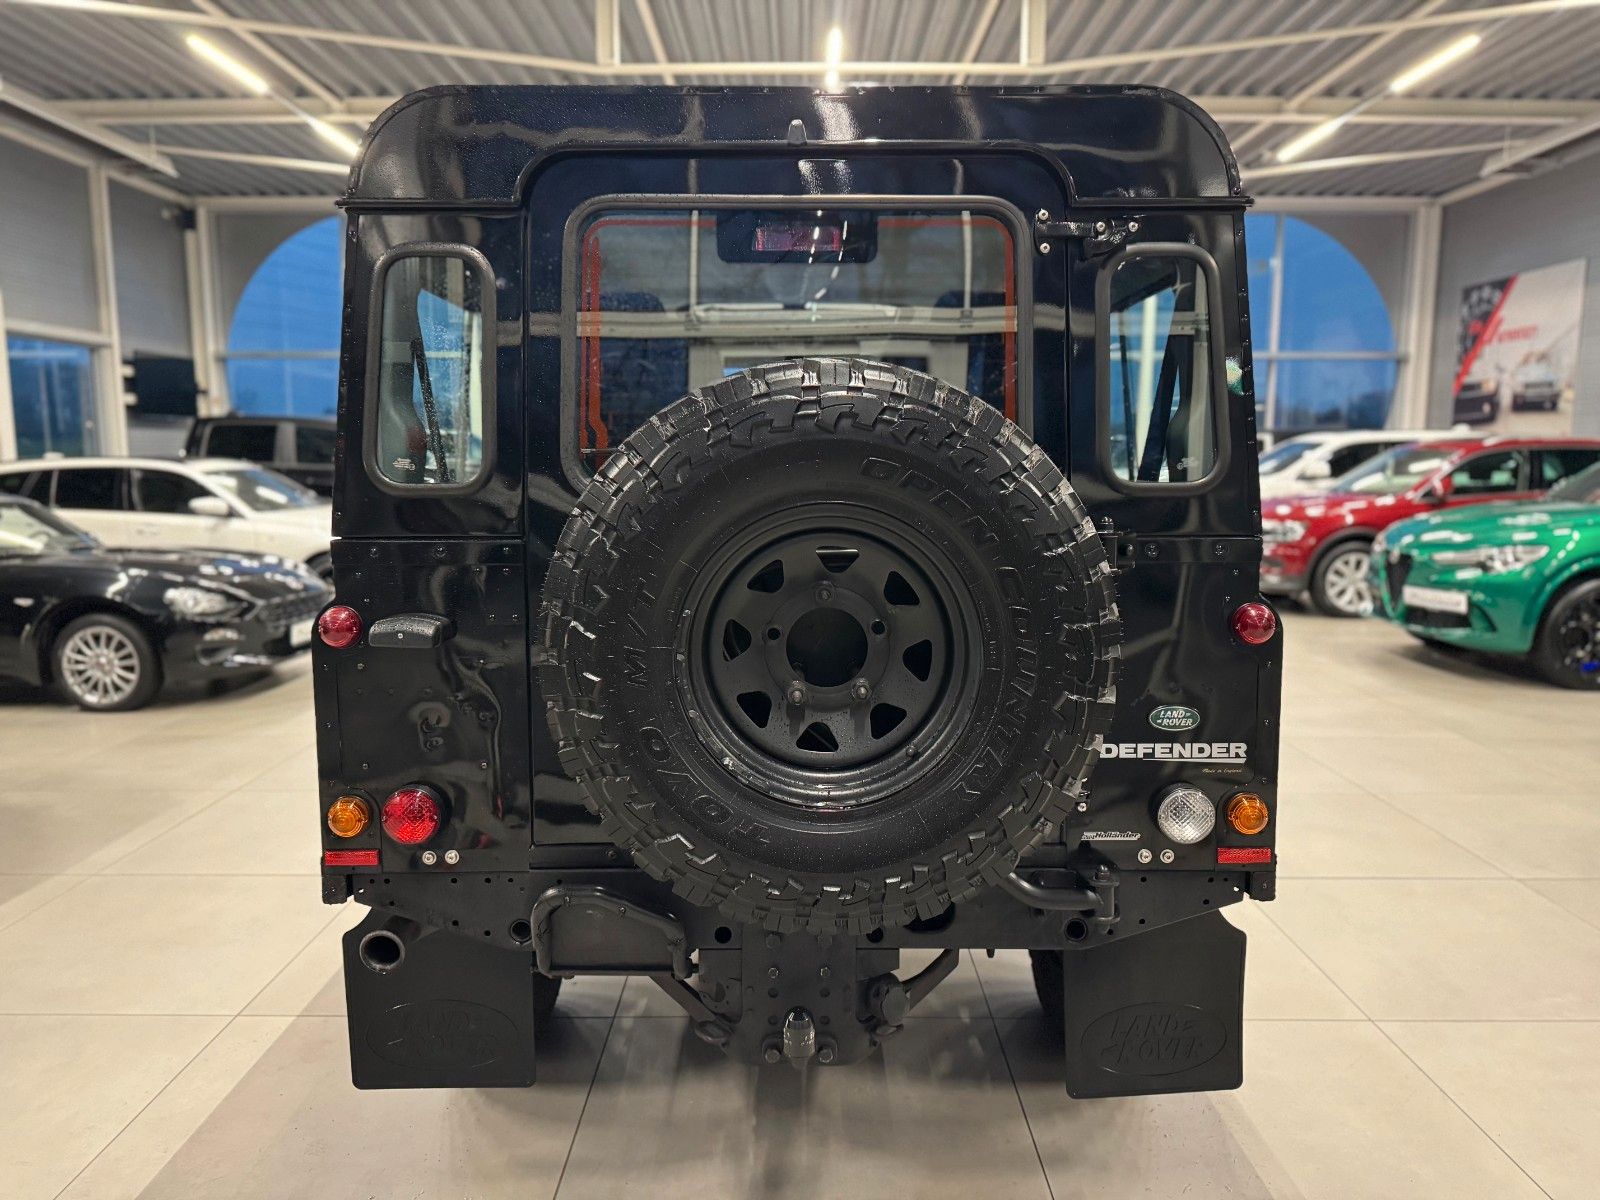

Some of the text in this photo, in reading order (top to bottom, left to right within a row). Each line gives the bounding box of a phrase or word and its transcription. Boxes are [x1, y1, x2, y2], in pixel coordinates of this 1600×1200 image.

[1159, 710, 1185, 718] LAND
[1162, 718, 1193, 726] ROVER
[1100, 743, 1248, 759] DEFENDER
